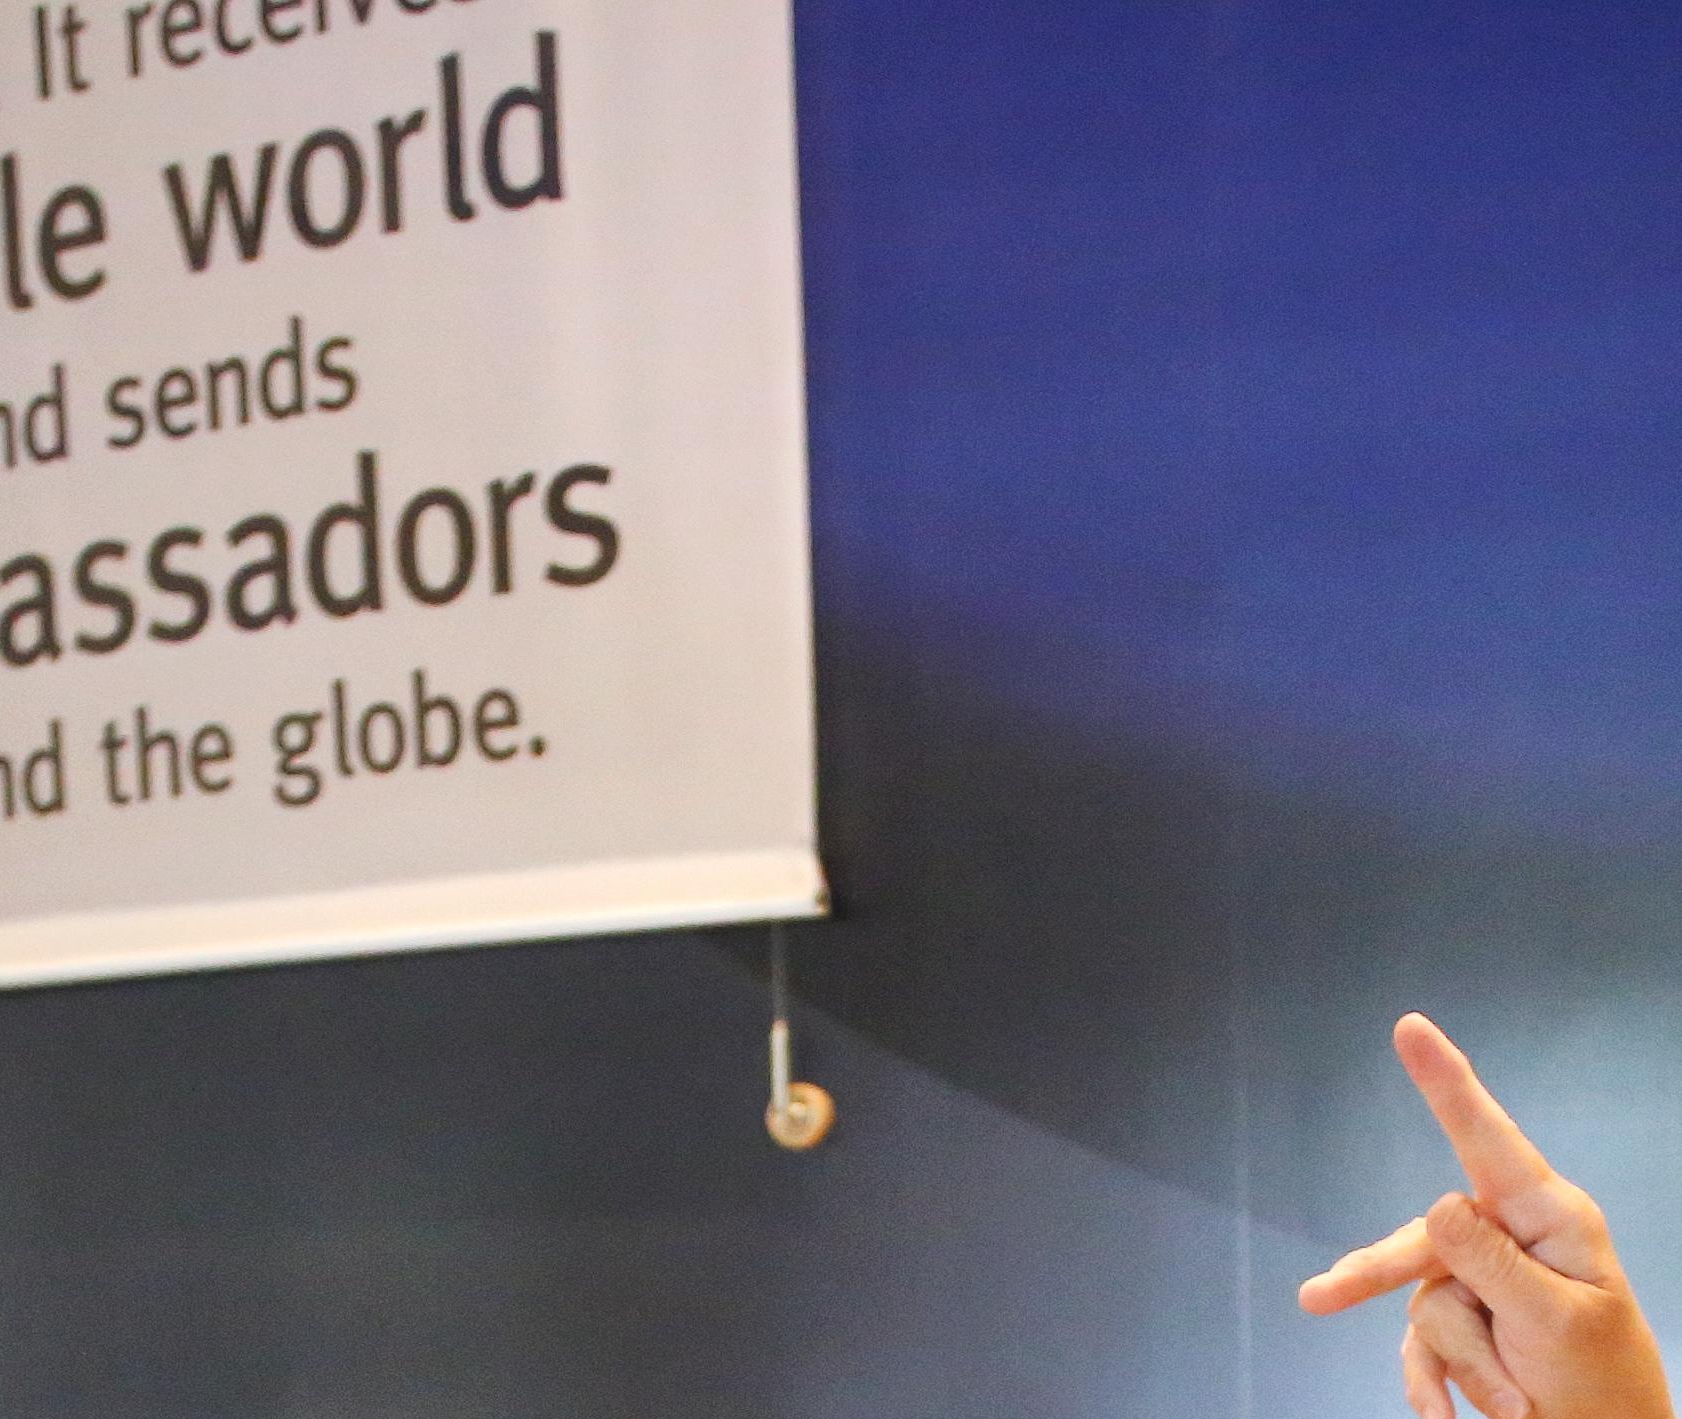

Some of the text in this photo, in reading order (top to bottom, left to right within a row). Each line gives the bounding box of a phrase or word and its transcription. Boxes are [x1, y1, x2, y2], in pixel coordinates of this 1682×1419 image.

[35, 6, 89, 100] It
[126, 0, 469, 78] rece
[164, 31, 564, 273] world
[107, 317, 357, 449] sends
[102, 707, 233, 806] the
[275, 670, 547, 806] globe.
